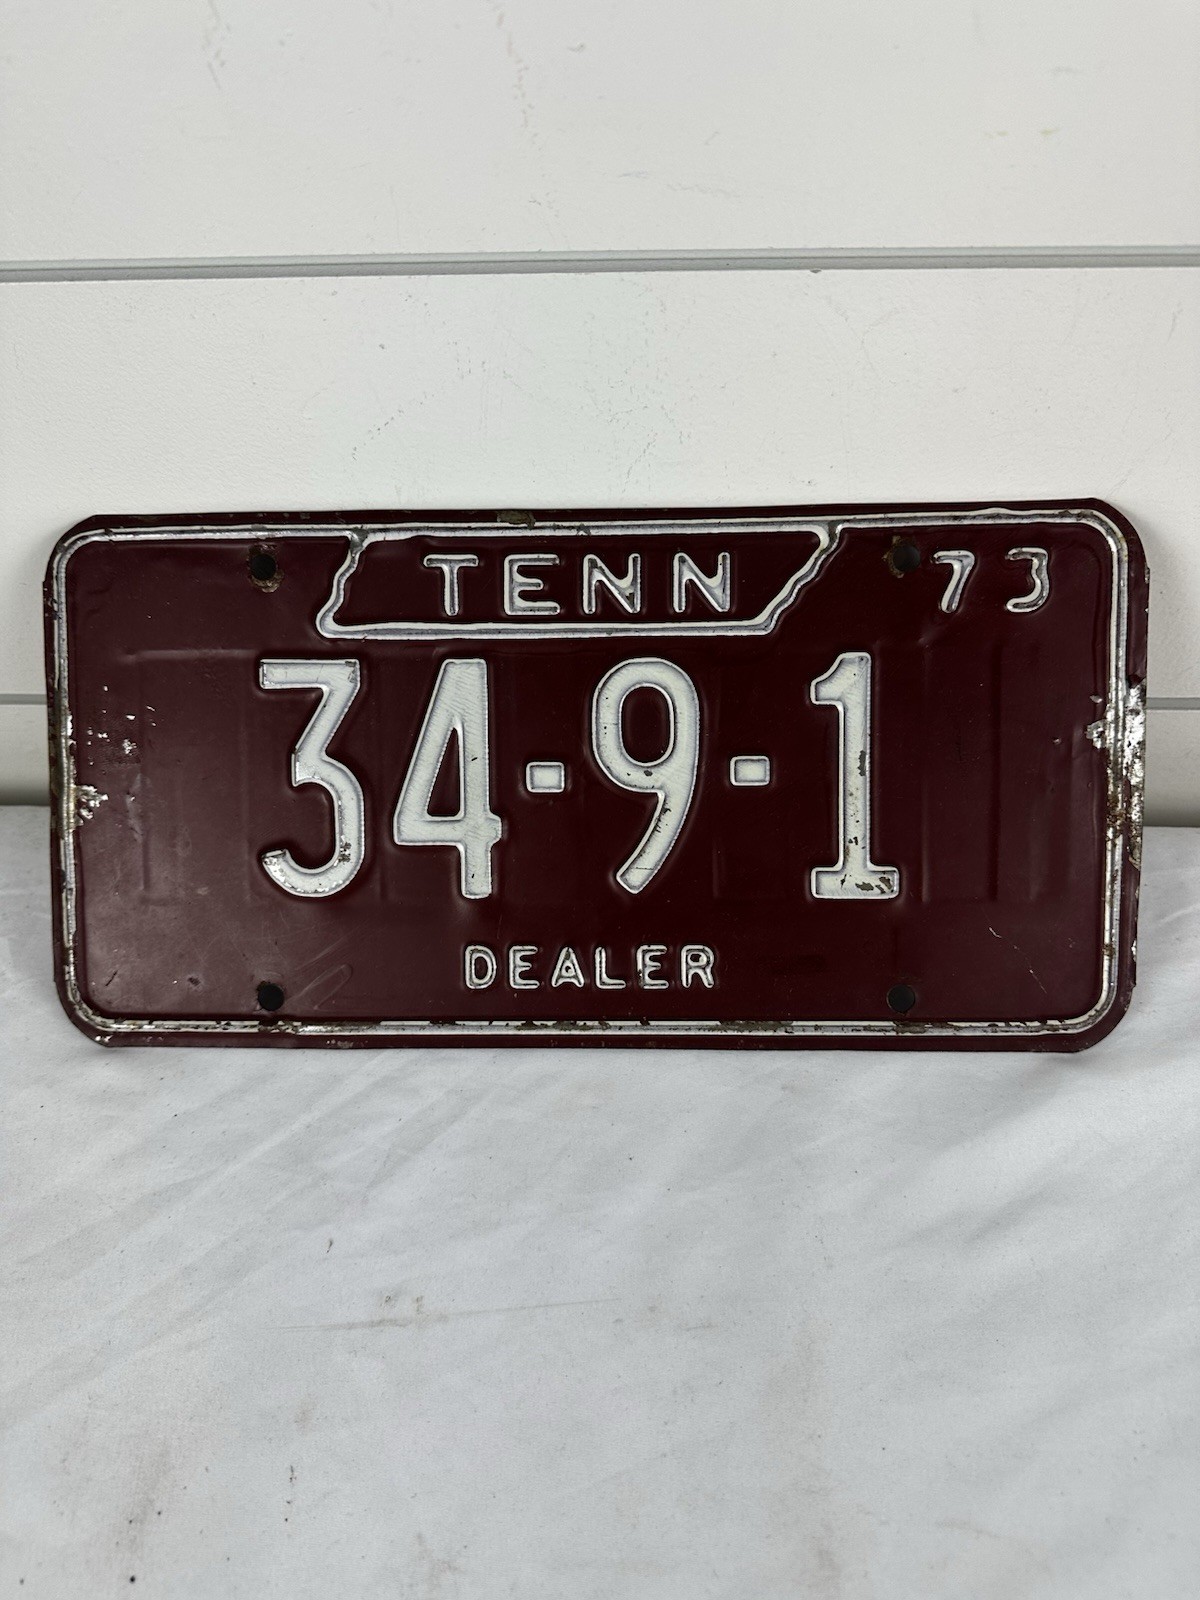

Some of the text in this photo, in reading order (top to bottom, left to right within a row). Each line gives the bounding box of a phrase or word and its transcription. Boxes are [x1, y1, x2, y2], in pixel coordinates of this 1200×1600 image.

[422, 551, 732, 616] TENN
[933, 547, 1050, 613] 73
[258, 651, 900, 901] 34-9-1
[463, 944, 716, 990] DEALER
